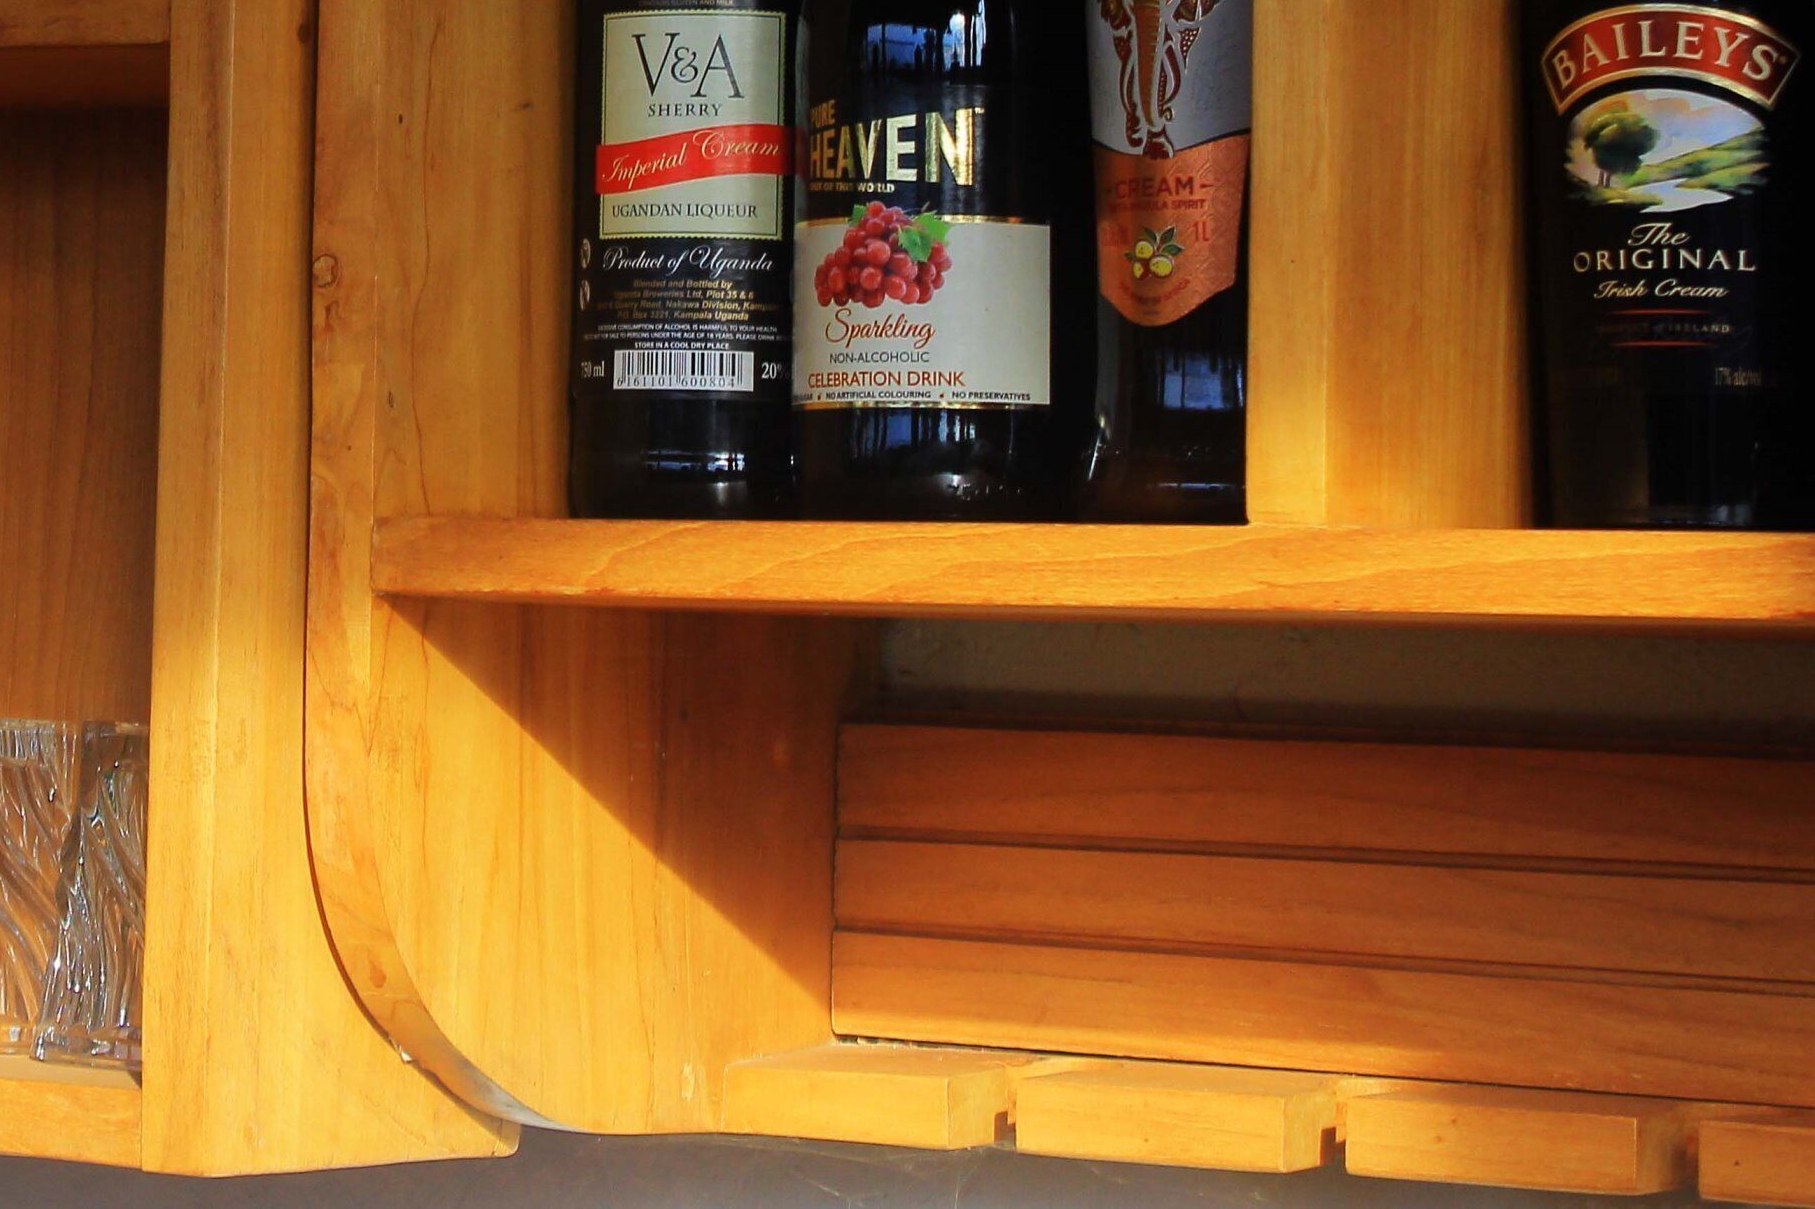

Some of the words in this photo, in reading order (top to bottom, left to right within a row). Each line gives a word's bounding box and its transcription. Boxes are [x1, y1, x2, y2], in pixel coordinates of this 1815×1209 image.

[1552, 20, 1778, 90] BAILEYS
[632, 33, 745, 99] V&A
[648, 103, 723, 118] SHERRY
[810, 98, 836, 126] PURE
[809, 106, 974, 187] HEAVEN
[602, 142, 688, 189] Imperial
[692, 129, 780, 160] Cream
[1115, 176, 1195, 198] CREAM
[612, 203, 682, 217] UGANDAN
[686, 203, 758, 219] LIQUEUR
[1171, 199, 1206, 210] SPIRIT
[1627, 222, 1691, 246] The
[603, 246, 665, 271] Product
[666, 249, 691, 277] of
[689, 246, 778, 279] Uganda
[1573, 247, 1758, 273] ORIGINAL
[633, 279, 667, 288] Blended
[668, 279, 685, 288] and
[687, 279, 719, 288] Bottled
[721, 280, 733, 290] by
[1594, 278, 1648, 299] Irish
[1653, 277, 1731, 298] Cream
[706, 290, 724, 298] Plot
[701, 301, 741, 311] Division,
[674, 311, 712, 321] Kampala
[714, 311, 749, 322] Uganda
[664, 323, 690, 331] ALCOHOL
[825, 307, 935, 349] Sparkling
[829, 351, 930, 363] NON-ALCOHOLIC
[593, 360, 605, 377] ml
[808, 371, 901, 388] CELEBRATION
[907, 371, 966, 387] DRINK
[826, 392, 835, 400] NO
[837, 391, 876, 400] ARTIFICIAL
[878, 391, 932, 399] COLOURING
[951, 391, 966, 400] NO
[968, 391, 1031, 401] PRESERVATIVES
